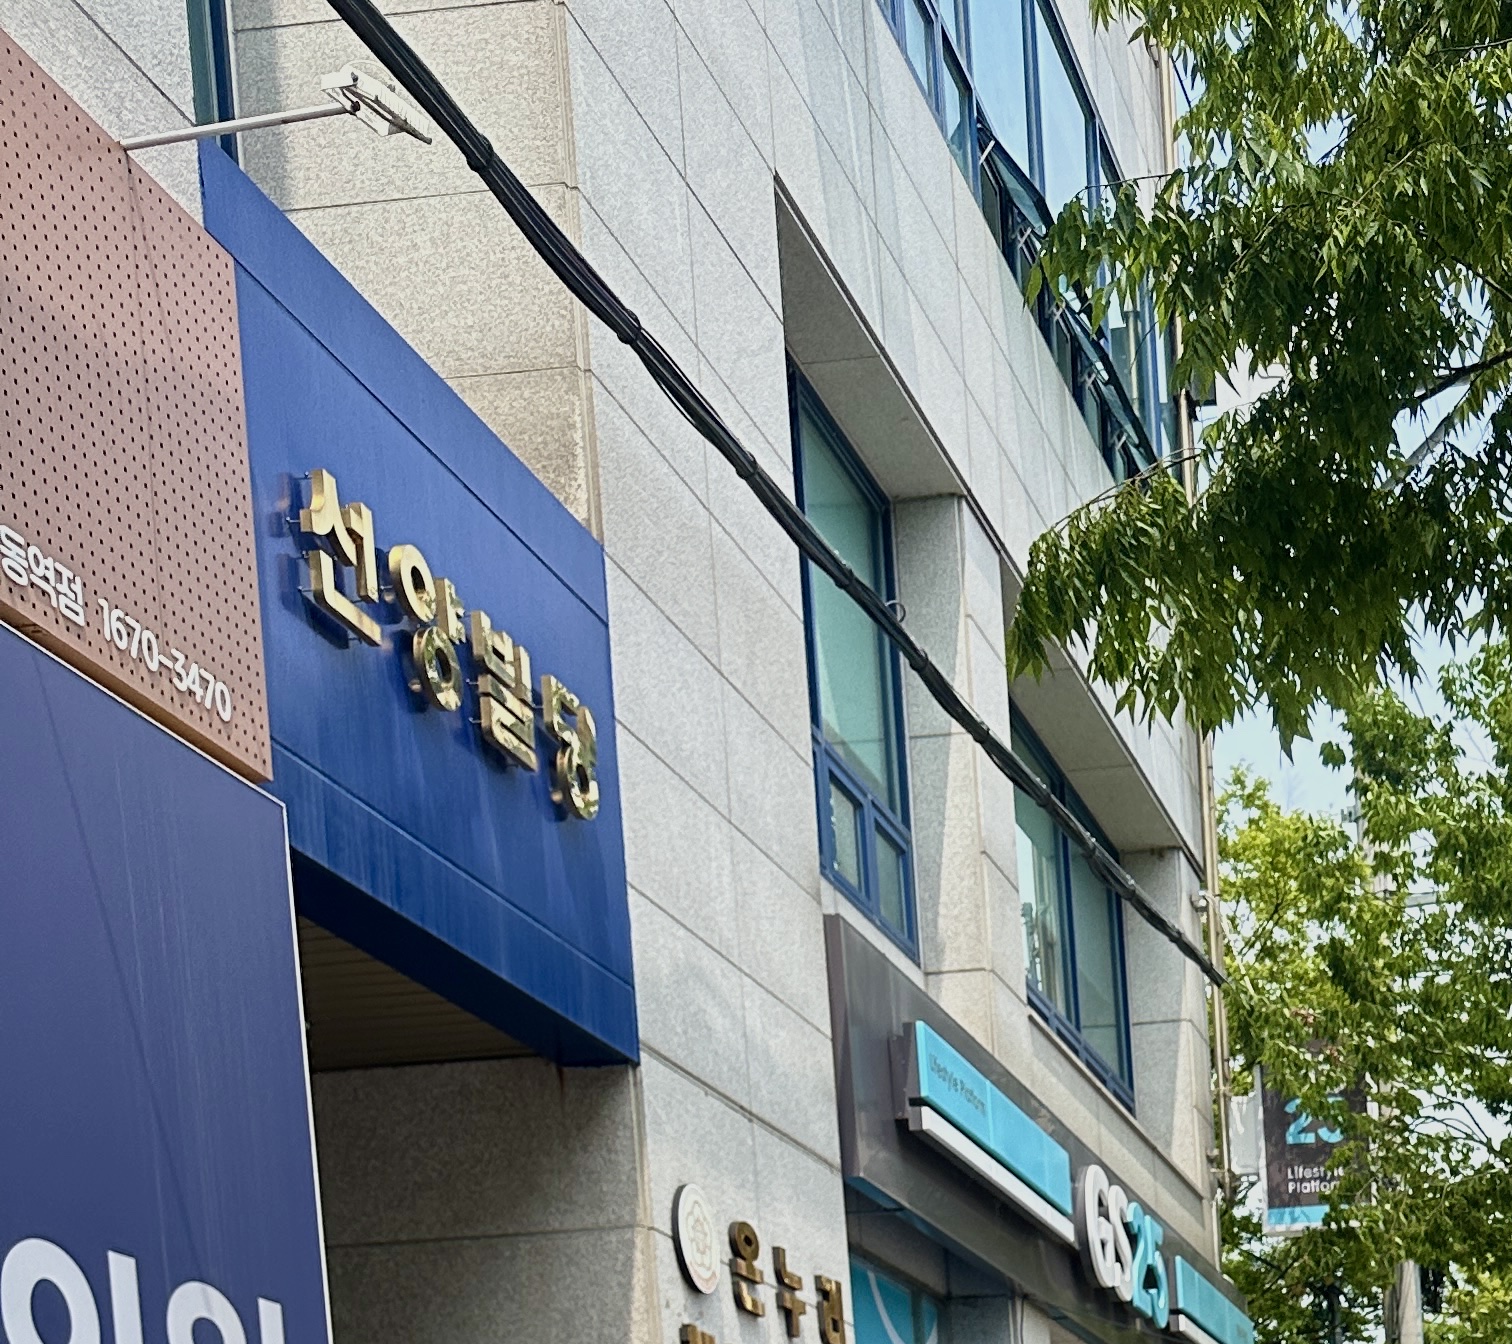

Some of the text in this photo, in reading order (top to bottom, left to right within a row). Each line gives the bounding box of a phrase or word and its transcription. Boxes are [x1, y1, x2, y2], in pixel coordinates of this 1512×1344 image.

[0, 524, 231, 721] 동역점 1670-3470
[299, 468, 599, 821] 선양빌딩
[1084, 1163, 1170, 1330] GS25
[1287, 1180, 1340, 1195] Platfor
